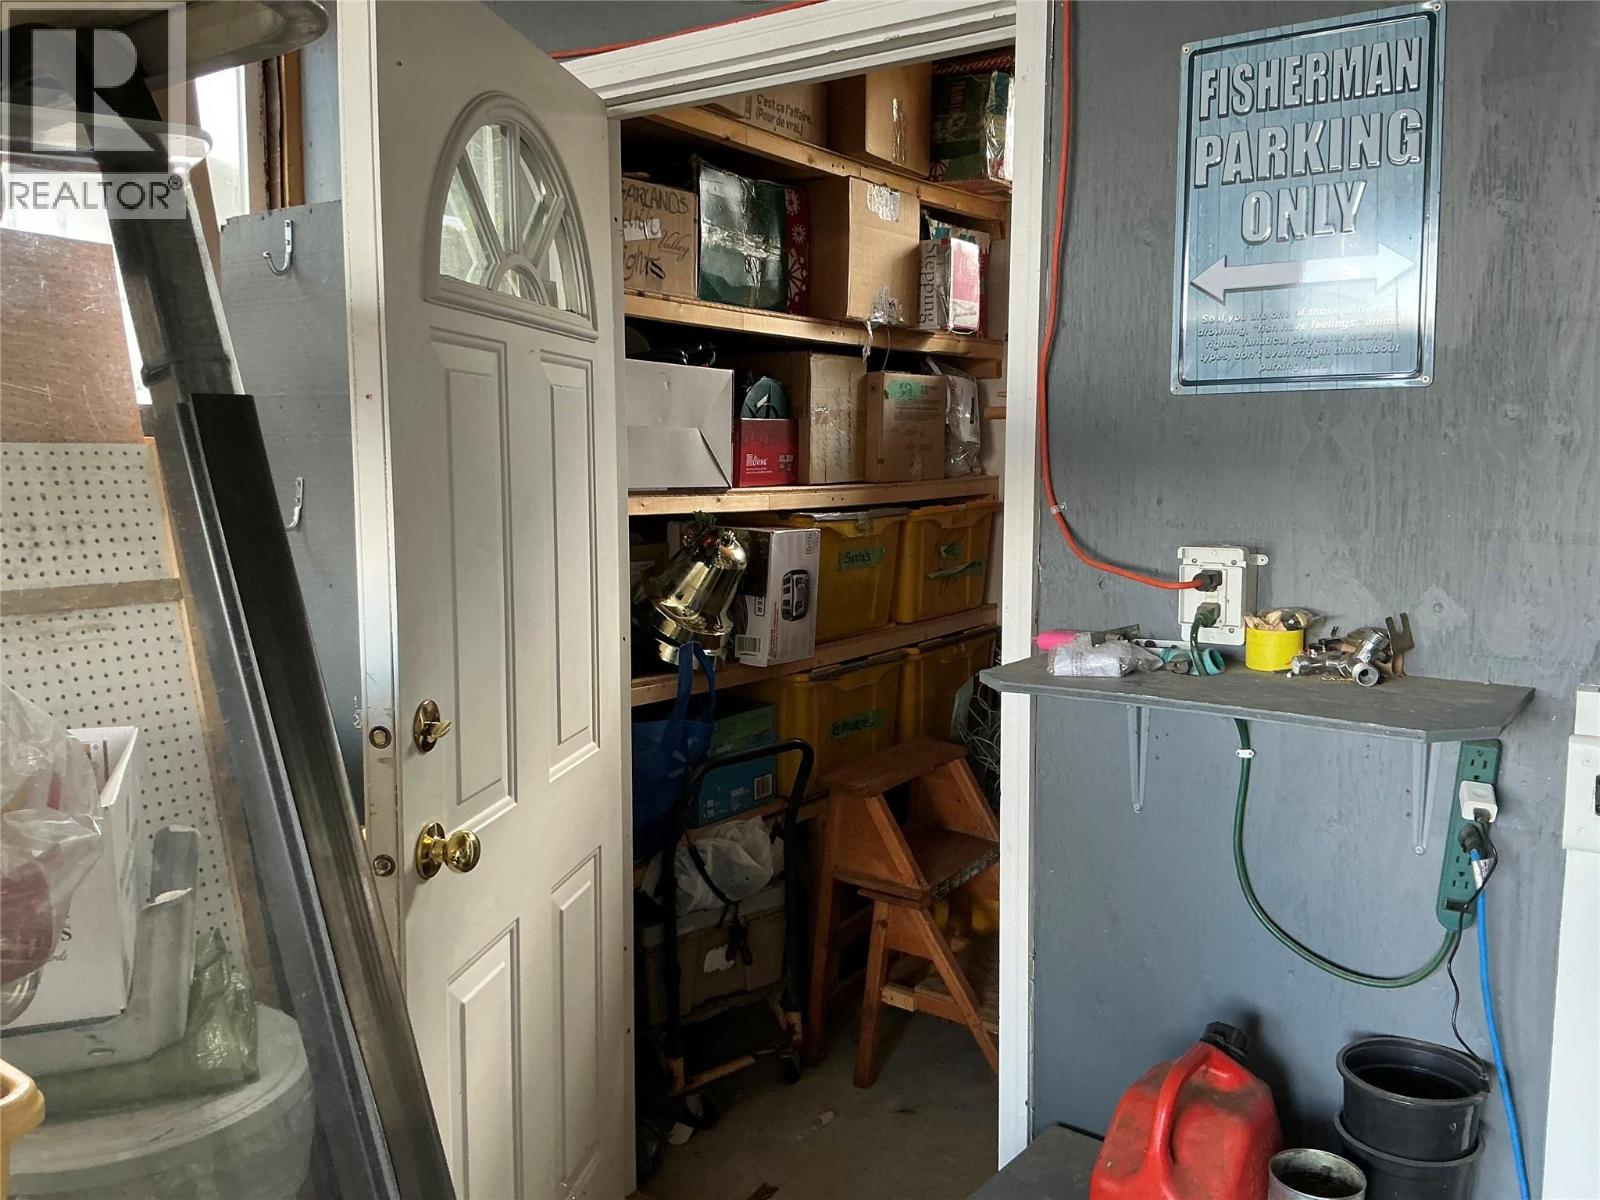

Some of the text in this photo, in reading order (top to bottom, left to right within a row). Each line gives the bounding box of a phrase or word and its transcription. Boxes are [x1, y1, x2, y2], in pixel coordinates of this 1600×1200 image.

[1198, 36, 1422, 122] FISHERMAN
[756, 93, 775, 110] C'est
[755, 105, 775, 123] (Pour
[776, 116, 785, 128] de
[1193, 107, 1423, 189] PARKING
[622, 184, 689, 215] ARLANDS
[1240, 179, 1368, 246] ONLY
[657, 229, 692, 262] Valley
[919, 242, 938, 324] Stepping
[1202, 313, 1215, 325] So
[1217, 312, 1225, 324] if
[1227, 311, 1248, 325] you
[1250, 311, 1268, 321] are
[1197, 326, 1249, 338] drowning,
[1200, 352, 1231, 365] types,
[1234, 350, 1262, 361] don't
[1264, 350, 1290, 359] even
[1334, 344, 1363, 356] think
[1366, 343, 1400, 354] about
[1206, 339, 1239, 351] rights,
[1258, 360, 1300, 374] parking
